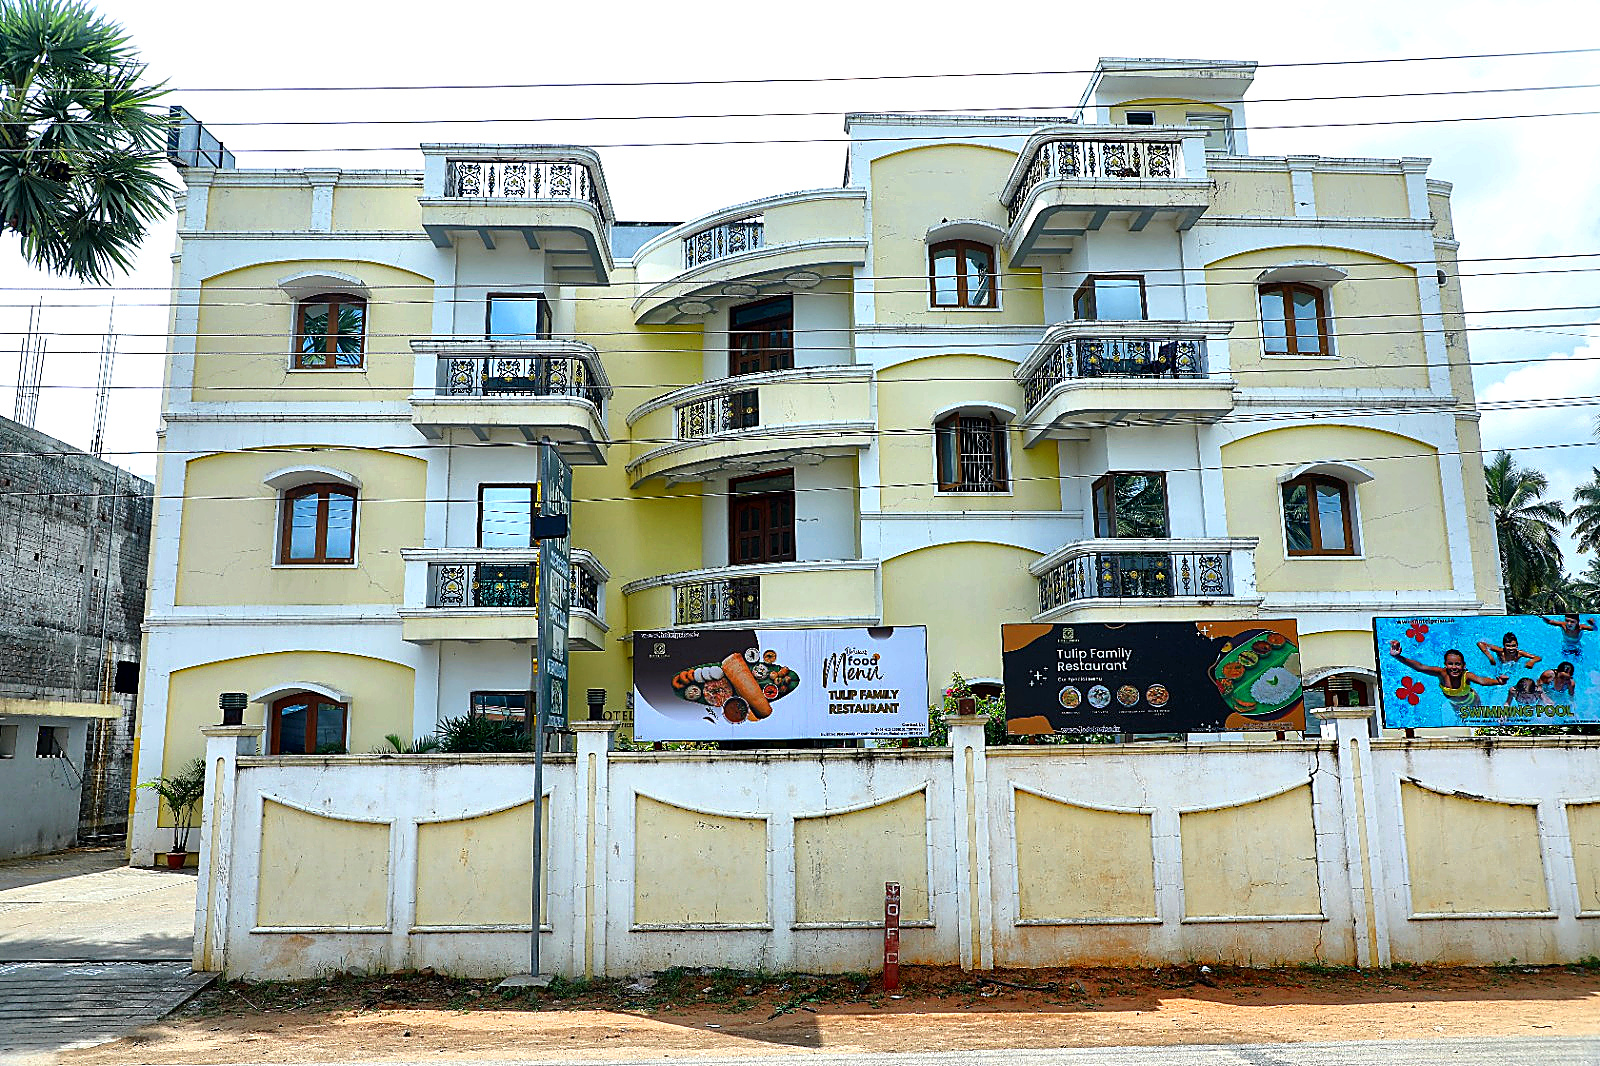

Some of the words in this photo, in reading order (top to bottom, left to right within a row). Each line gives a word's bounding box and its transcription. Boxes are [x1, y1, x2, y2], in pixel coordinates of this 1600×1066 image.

[848, 656, 878, 666] food
[1056, 648, 1087, 662] Tulip
[1090, 647, 1132, 661] Family
[822, 652, 886, 689] Menu
[1057, 660, 1128, 672] Restaurant
[828, 690, 858, 700] TULIP
[859, 689, 900, 700] FAMILY
[828, 702, 900, 715] RESTAURANT
[1459, 704, 1534, 719] SWIMMING
[1535, 703, 1575, 717] POOL
